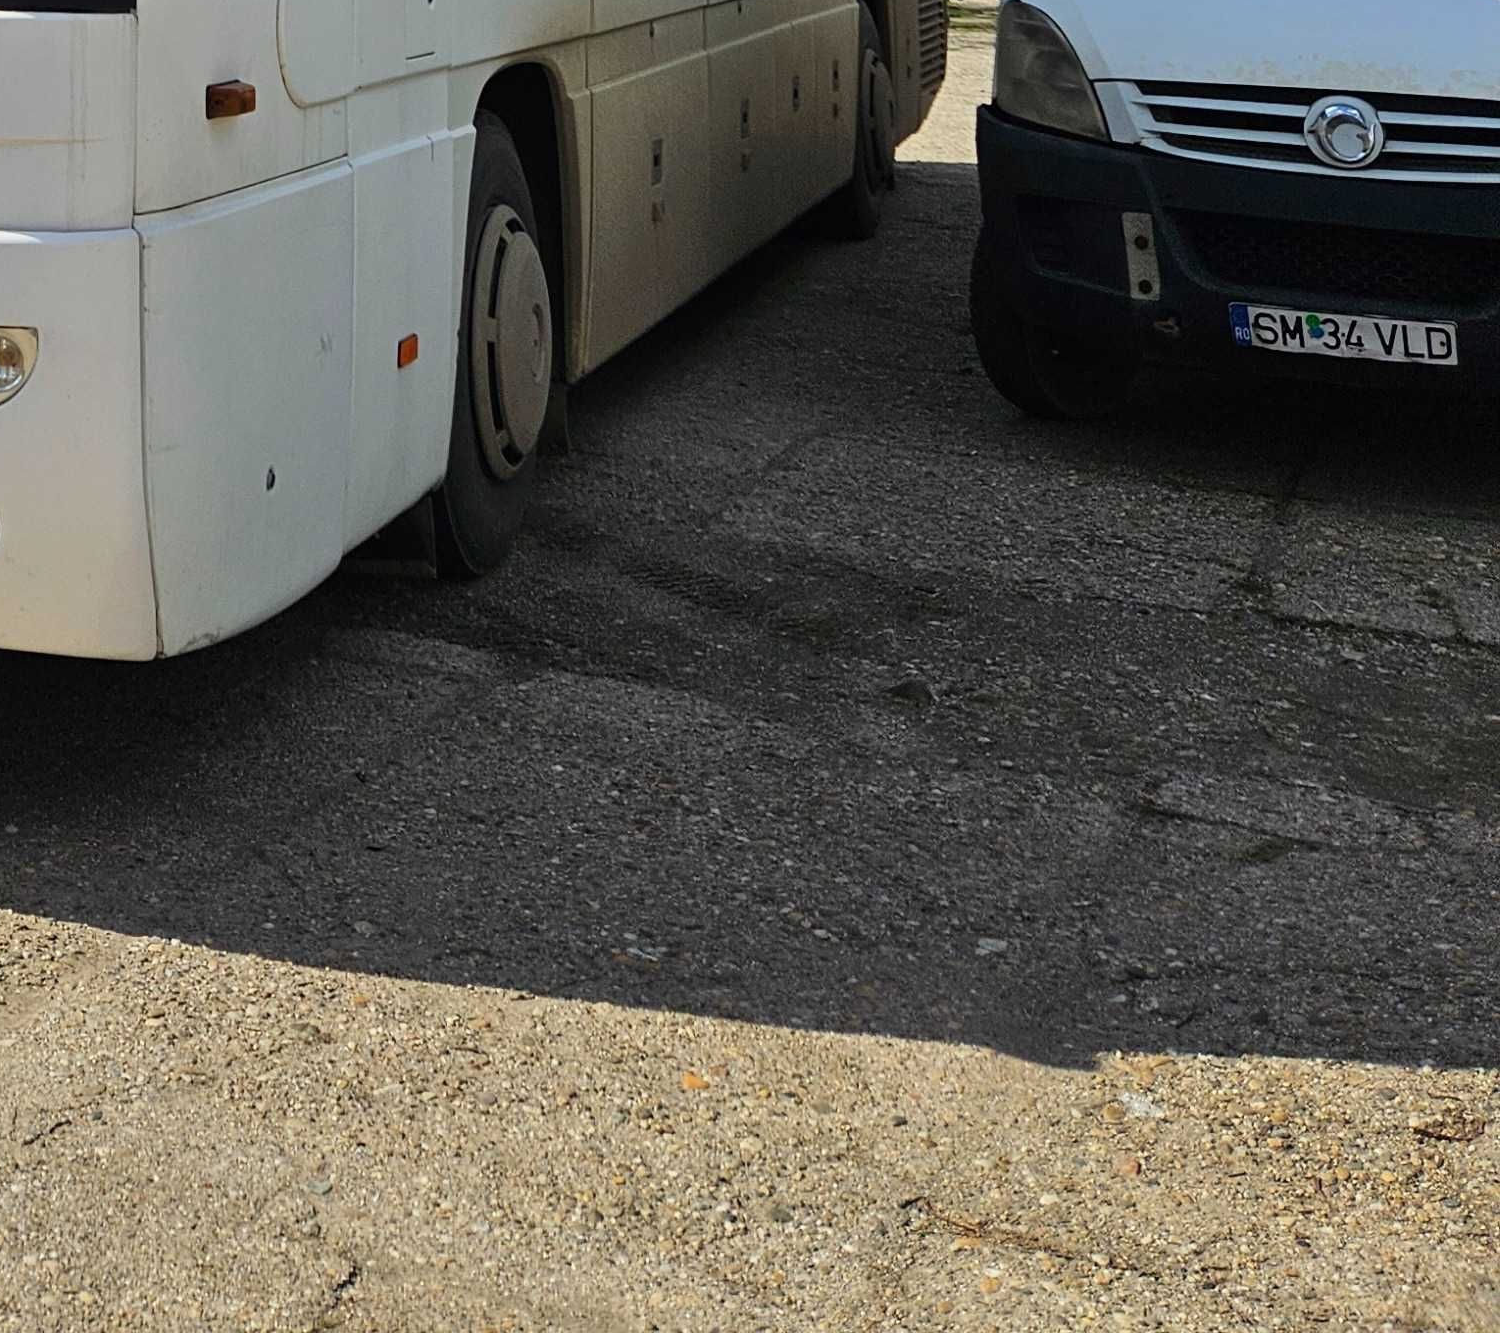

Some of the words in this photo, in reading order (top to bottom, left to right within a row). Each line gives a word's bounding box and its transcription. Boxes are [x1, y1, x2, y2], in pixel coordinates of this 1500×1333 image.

[1235, 326, 1250, 340] RO
[1252, 312, 1305, 348] SM
[1322, 317, 1365, 351] 34
[1373, 321, 1453, 360] VLD
